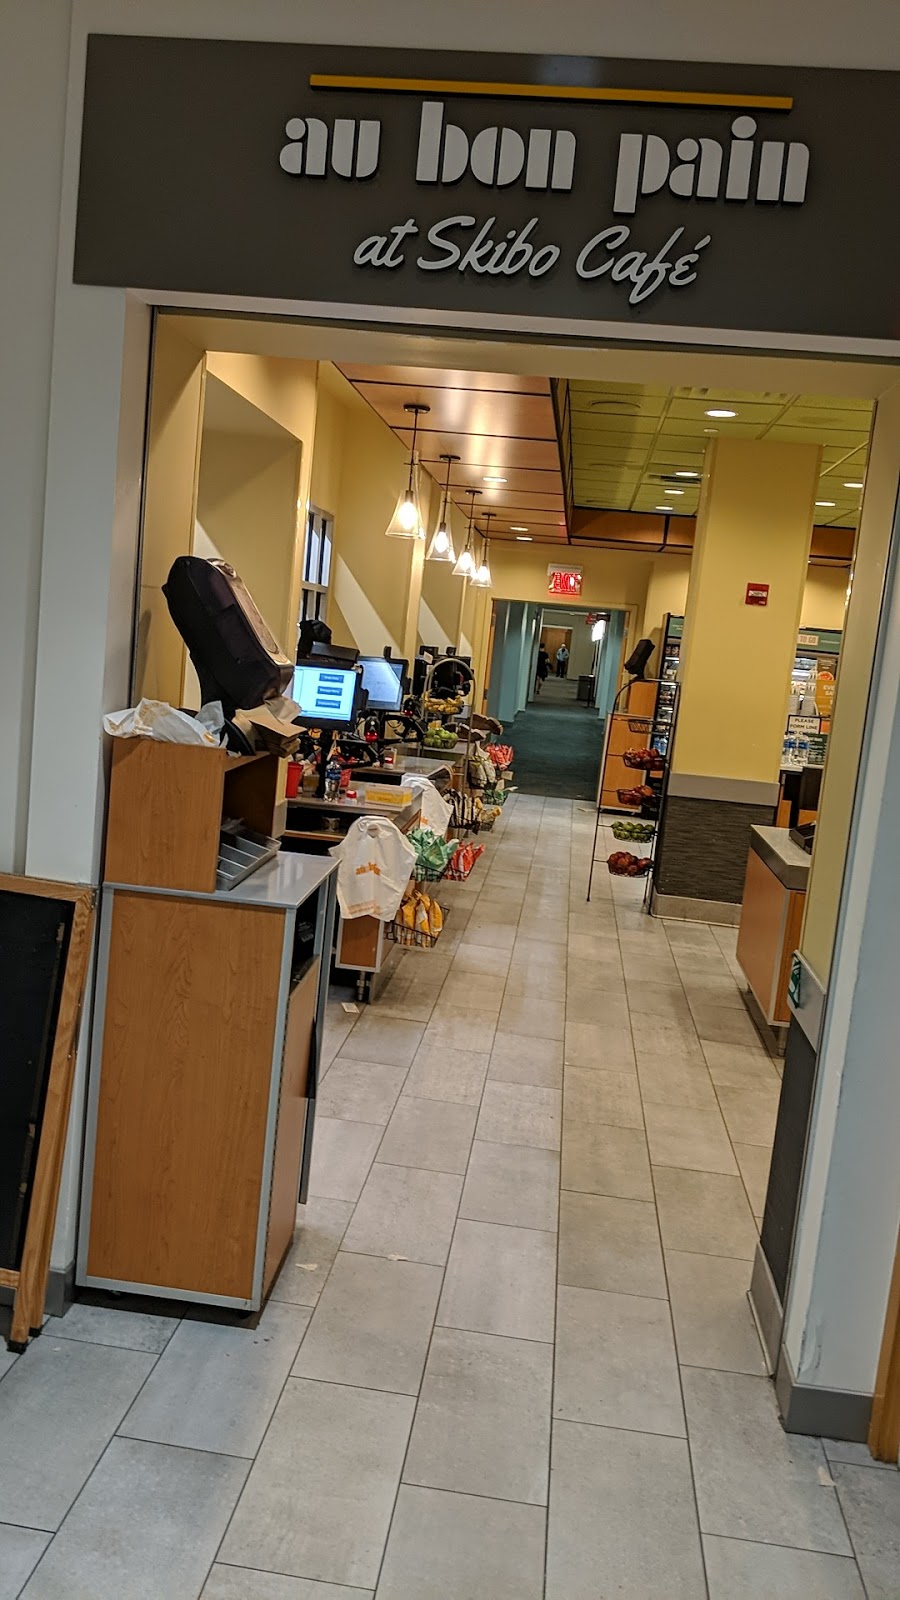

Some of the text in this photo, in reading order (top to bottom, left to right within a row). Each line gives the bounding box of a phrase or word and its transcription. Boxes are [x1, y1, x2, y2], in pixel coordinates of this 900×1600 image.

[279, 101, 811, 214] au bon pain
[353, 215, 712, 305] at Skibo Café
[808, 636, 817, 644] GO
